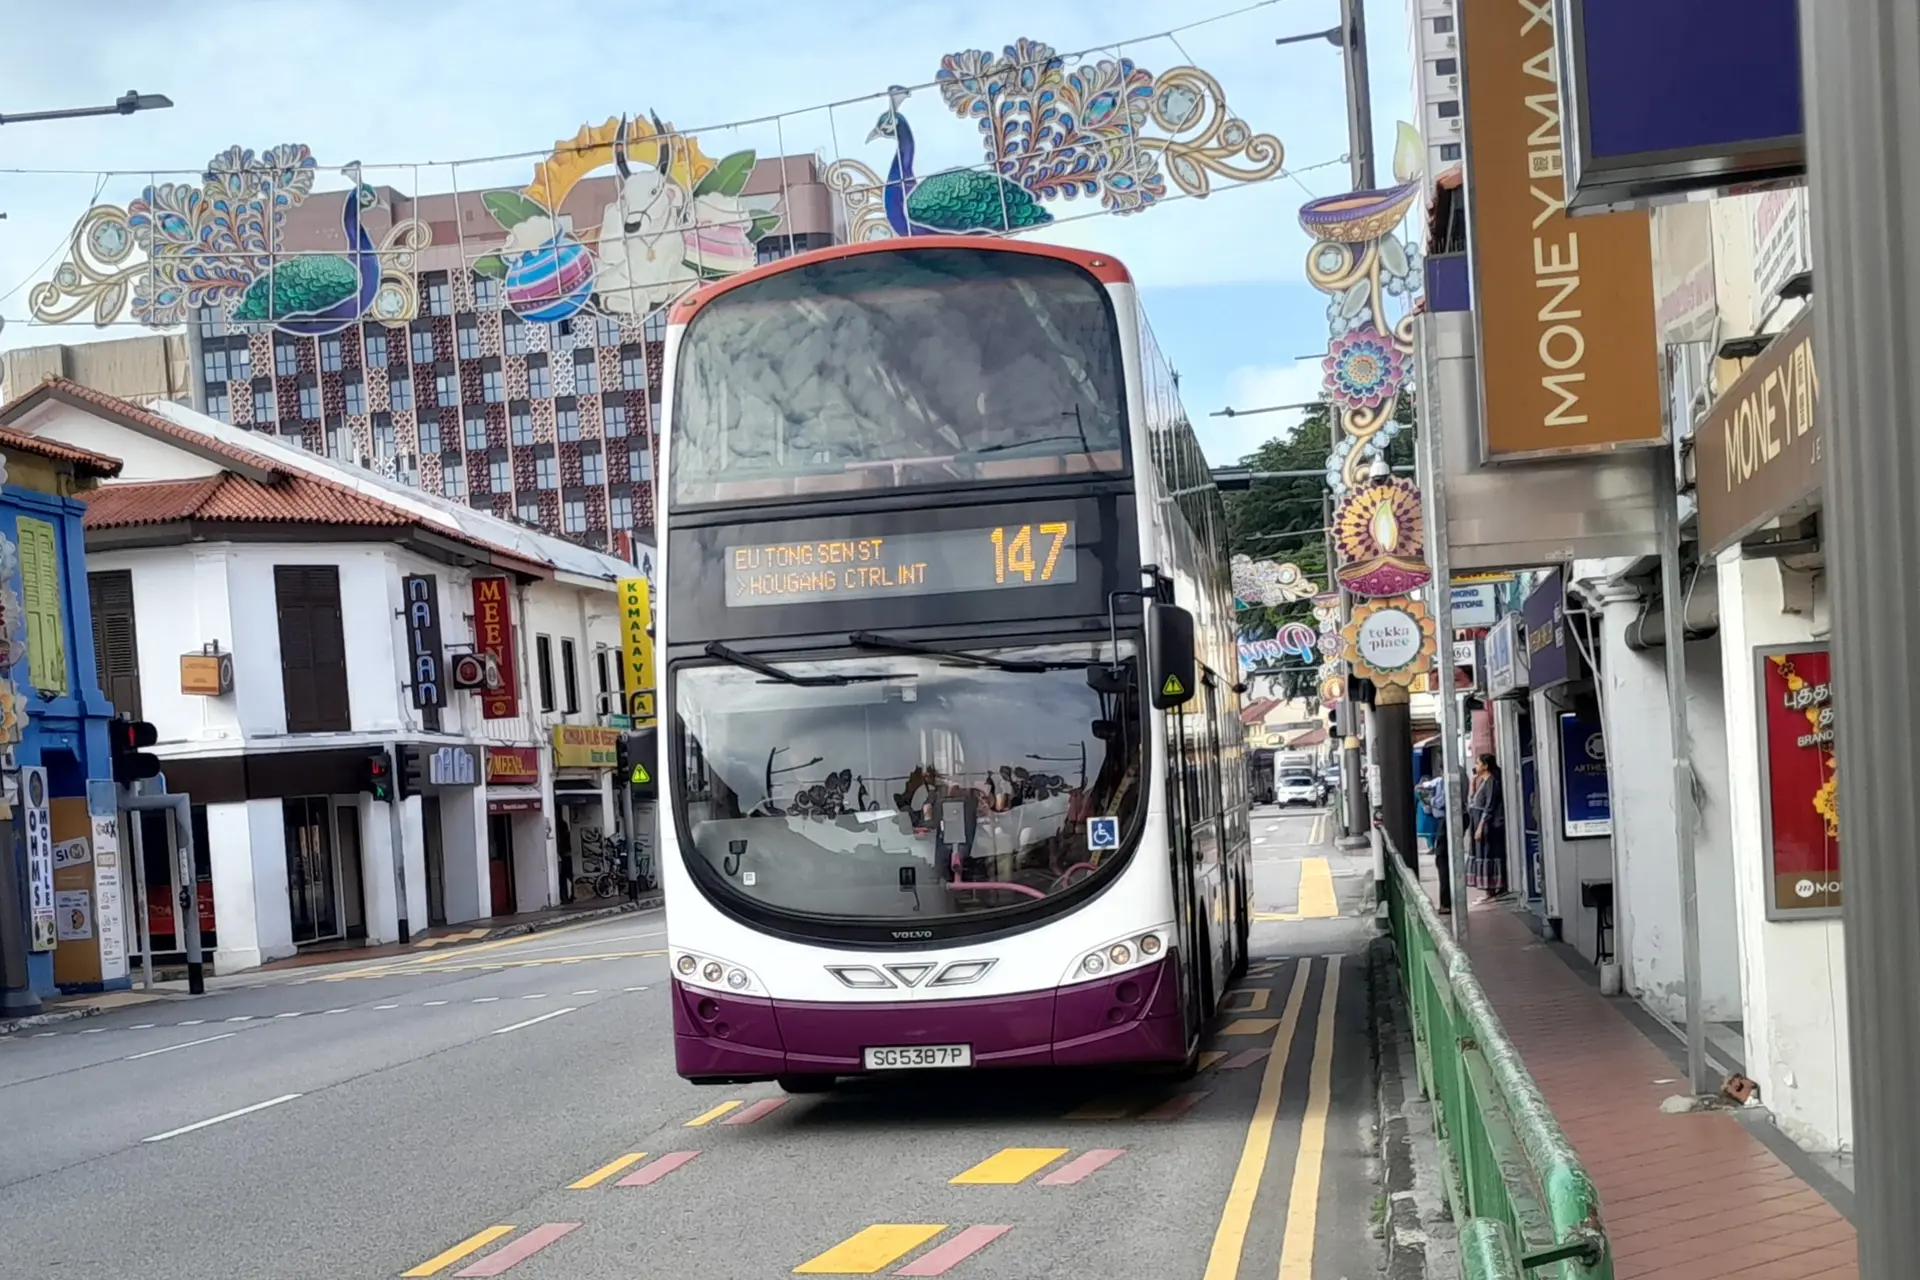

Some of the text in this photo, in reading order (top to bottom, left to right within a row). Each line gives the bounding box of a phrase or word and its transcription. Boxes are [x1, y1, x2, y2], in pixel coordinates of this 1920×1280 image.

[765, 545, 813, 568] TONG
[818, 541, 854, 565] SEN
[858, 539, 883, 560] ST
[991, 522, 1067, 584] 147
[844, 567, 893, 589] CTRL
[899, 563, 927, 585] INT
[39, 810, 50, 906] MOBILE
[891, 930, 933, 939] VOLVO
